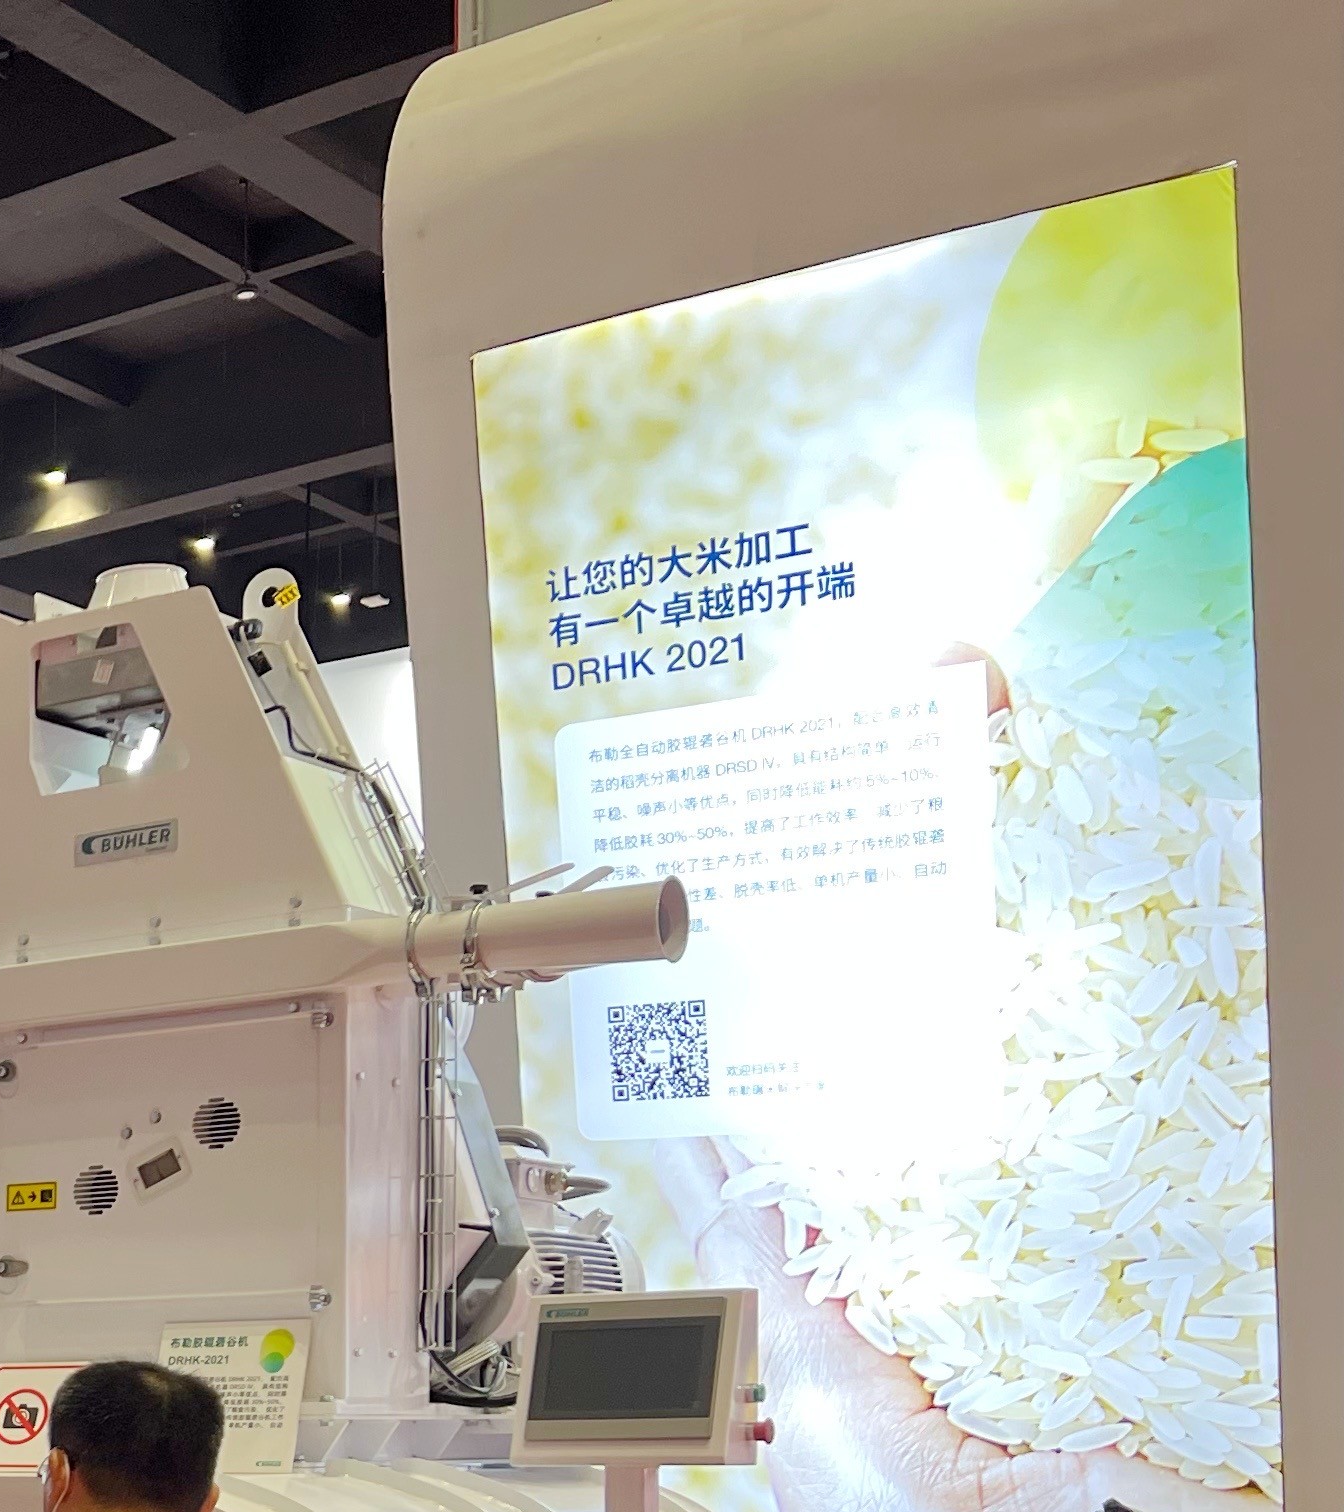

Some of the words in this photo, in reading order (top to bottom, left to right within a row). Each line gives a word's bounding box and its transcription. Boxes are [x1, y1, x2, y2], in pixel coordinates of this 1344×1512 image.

[545, 522, 813, 604] 让您的大米加工
[547, 560, 856, 649] 有一个卓越的开端
[551, 647, 656, 691] DRHK
[665, 632, 745, 673] 2021
[715, 759, 757, 777] DRSD
[168, 1355, 230, 1366] DRHK-2021
